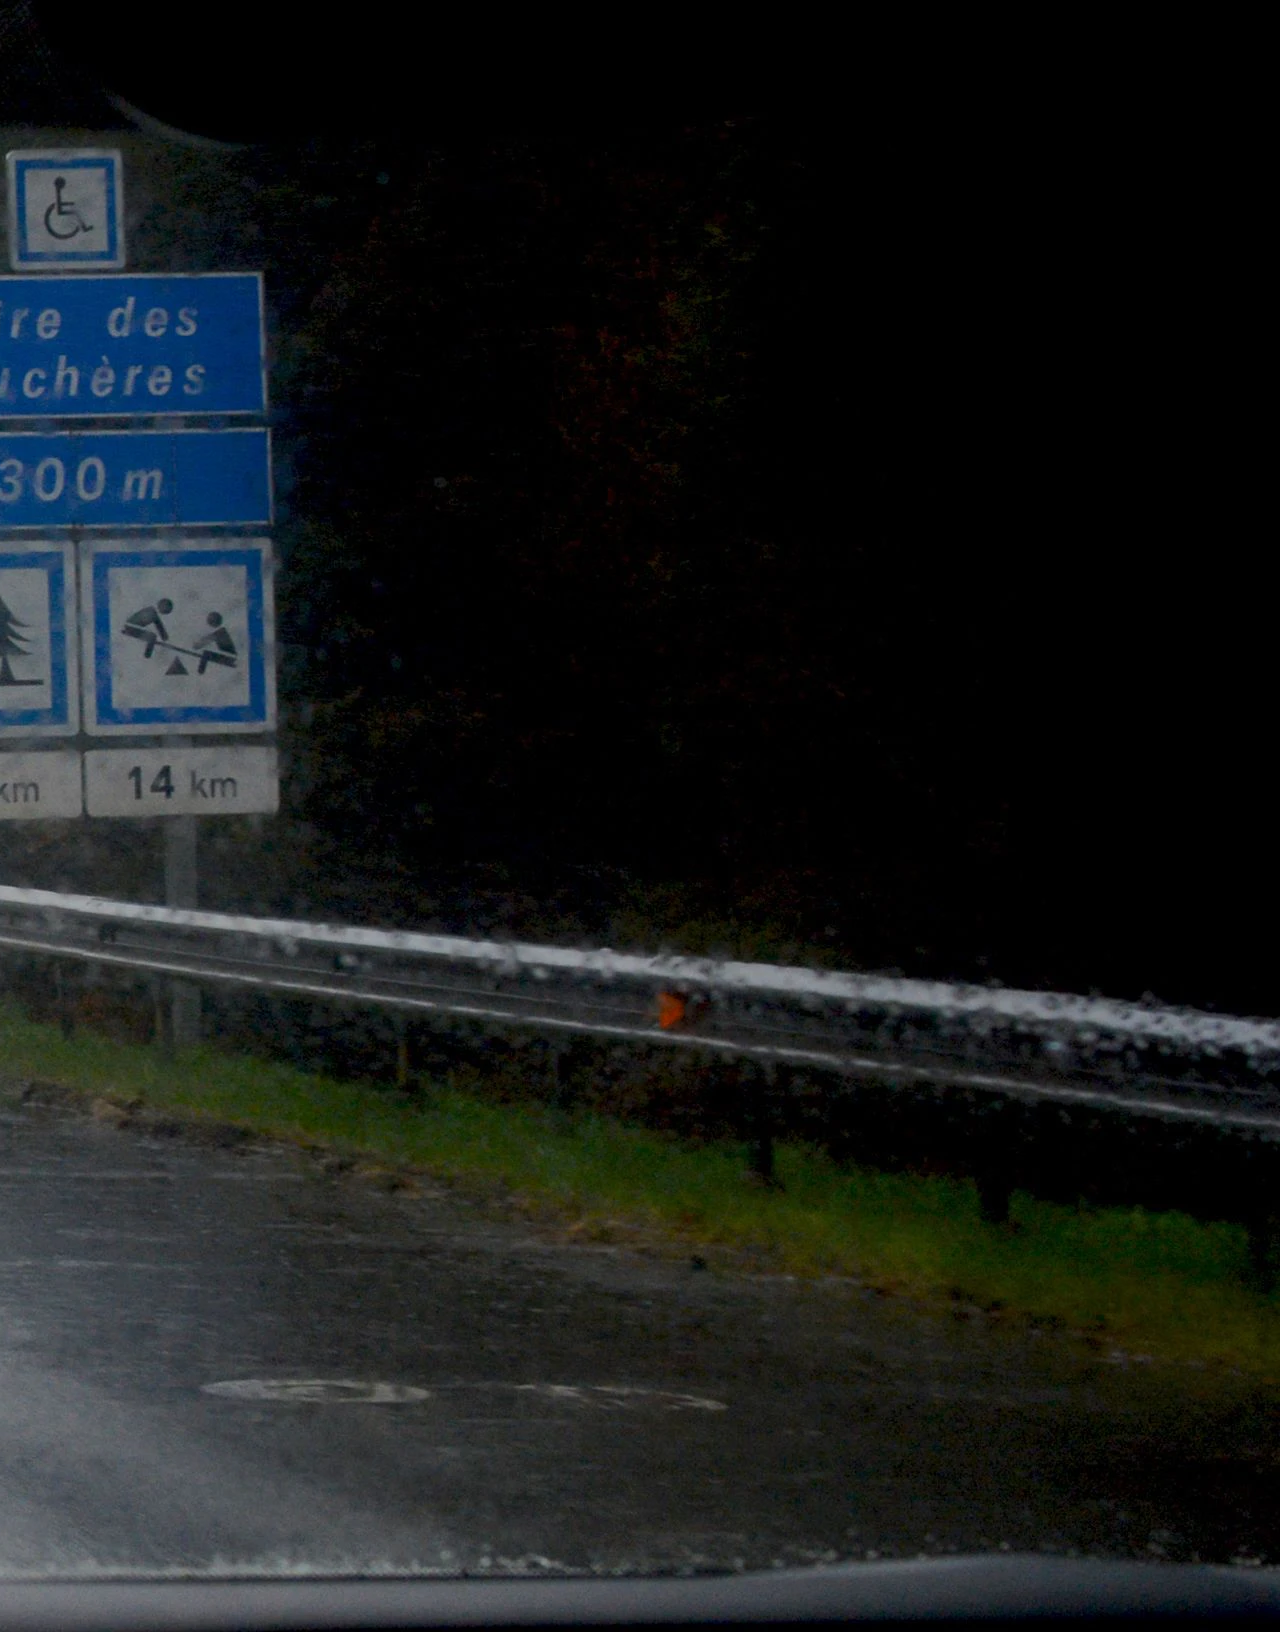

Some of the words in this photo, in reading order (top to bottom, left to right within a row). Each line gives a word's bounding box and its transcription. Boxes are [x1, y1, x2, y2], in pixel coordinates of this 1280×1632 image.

[107, 296, 200, 338] des
[121, 468, 164, 500] m
[127, 765, 175, 800] 14
[190, 770, 238, 800] km
